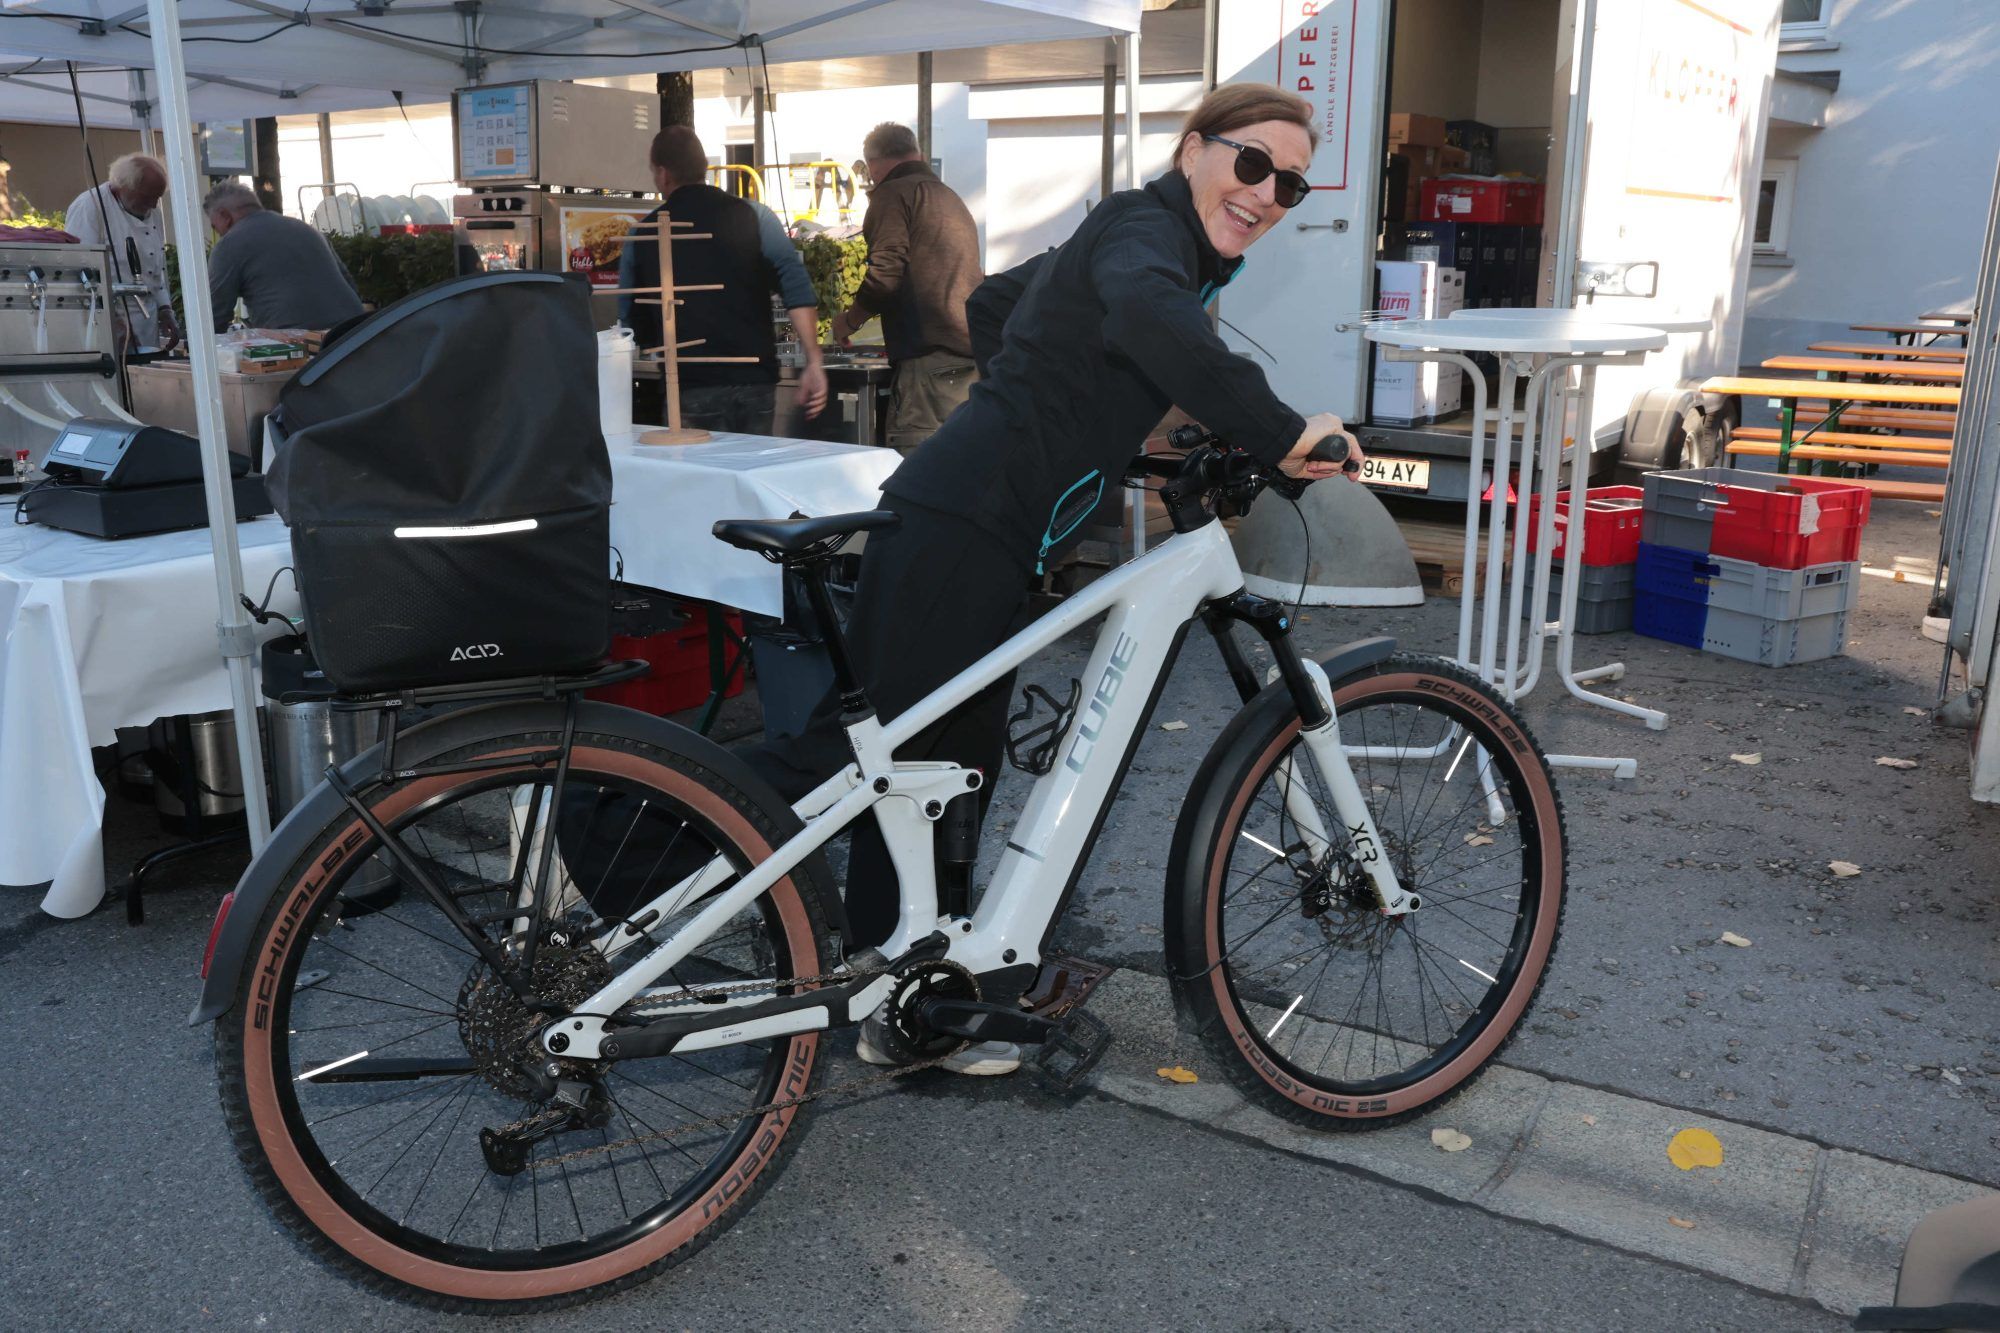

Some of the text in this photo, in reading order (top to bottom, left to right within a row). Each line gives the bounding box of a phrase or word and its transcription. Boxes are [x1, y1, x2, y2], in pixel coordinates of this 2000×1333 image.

[1329, 25, 1339, 92] METZGEREI
[1364, 460, 1416, 482] 94 AY
[1065, 631, 1138, 774] CUBE
[1416, 679, 1528, 754] SCHWALBE
[853, 736, 864, 752] HPA
[1347, 821, 1378, 863] XCR
[254, 827, 365, 1031] SCHWALBE
[1237, 1031, 1350, 1113] NOBBY NIC
[702, 1041, 810, 1219] NOBBY NIC
